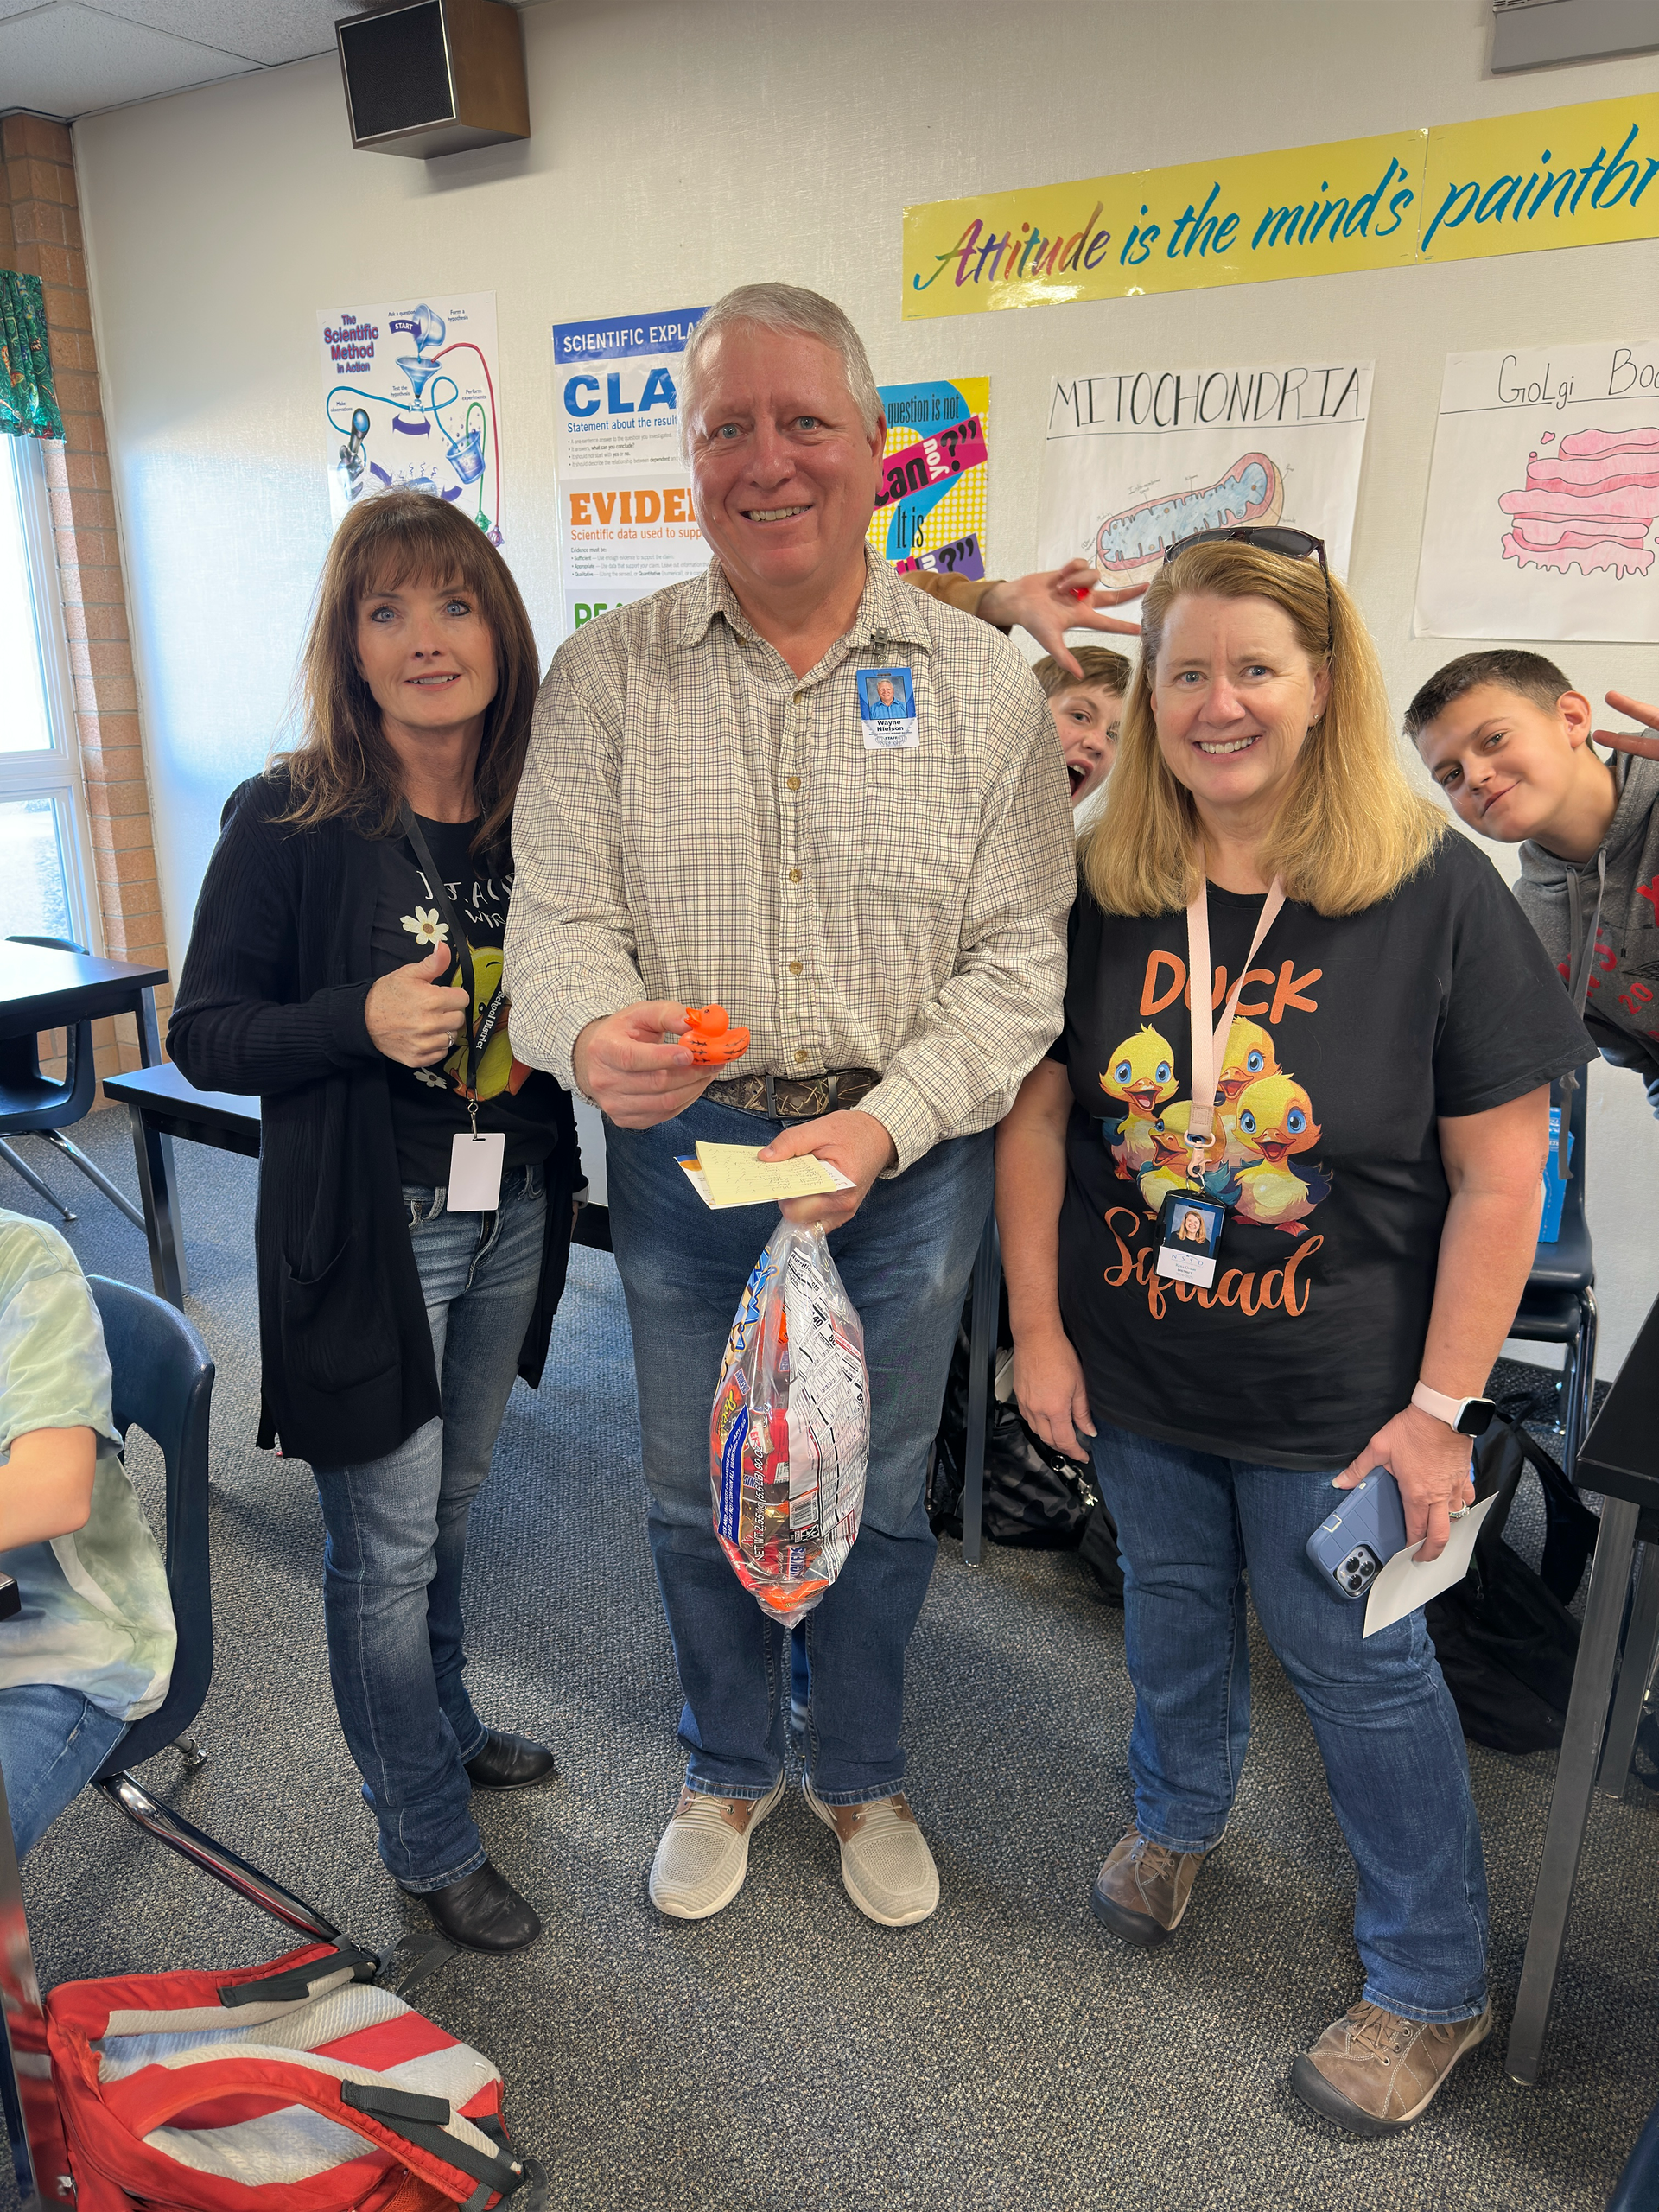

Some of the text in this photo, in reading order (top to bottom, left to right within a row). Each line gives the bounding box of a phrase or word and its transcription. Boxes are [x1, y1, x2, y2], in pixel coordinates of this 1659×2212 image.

[912, 200, 1111, 291] Attitude
[1120, 204, 1160, 266] is
[1166, 181, 1241, 258] the
[1250, 156, 1414, 251] mind's
[341, 314, 357, 326] The
[324, 323, 379, 344] Scientific
[563, 327, 644, 353] SCIENTIFIC
[330, 340, 375, 361] Method
[336, 360, 371, 373] in Action
[1048, 366, 1361, 430] MITOCHONDRIA
[887, 393, 960, 429] question is not
[568, 420, 609, 433] Statement
[612, 418, 635, 429] about
[638, 417, 652, 428] the
[923, 438, 950, 480] you
[570, 528, 614, 541] Scientific
[617, 528, 638, 539] data
[640, 527, 663, 539] used
[665, 527, 676, 538] to
[897, 505, 925, 549] It is
[1139, 949, 1324, 1025] DUCK
[476, 991, 505, 1050] School District
[753, 1445, 764, 1459] OZ
[753, 1459, 764, 1471] 90
[754, 1513, 765, 1531] 2.55
[753, 1532, 765, 1545] WT
[753, 1546, 765, 1561] NET
